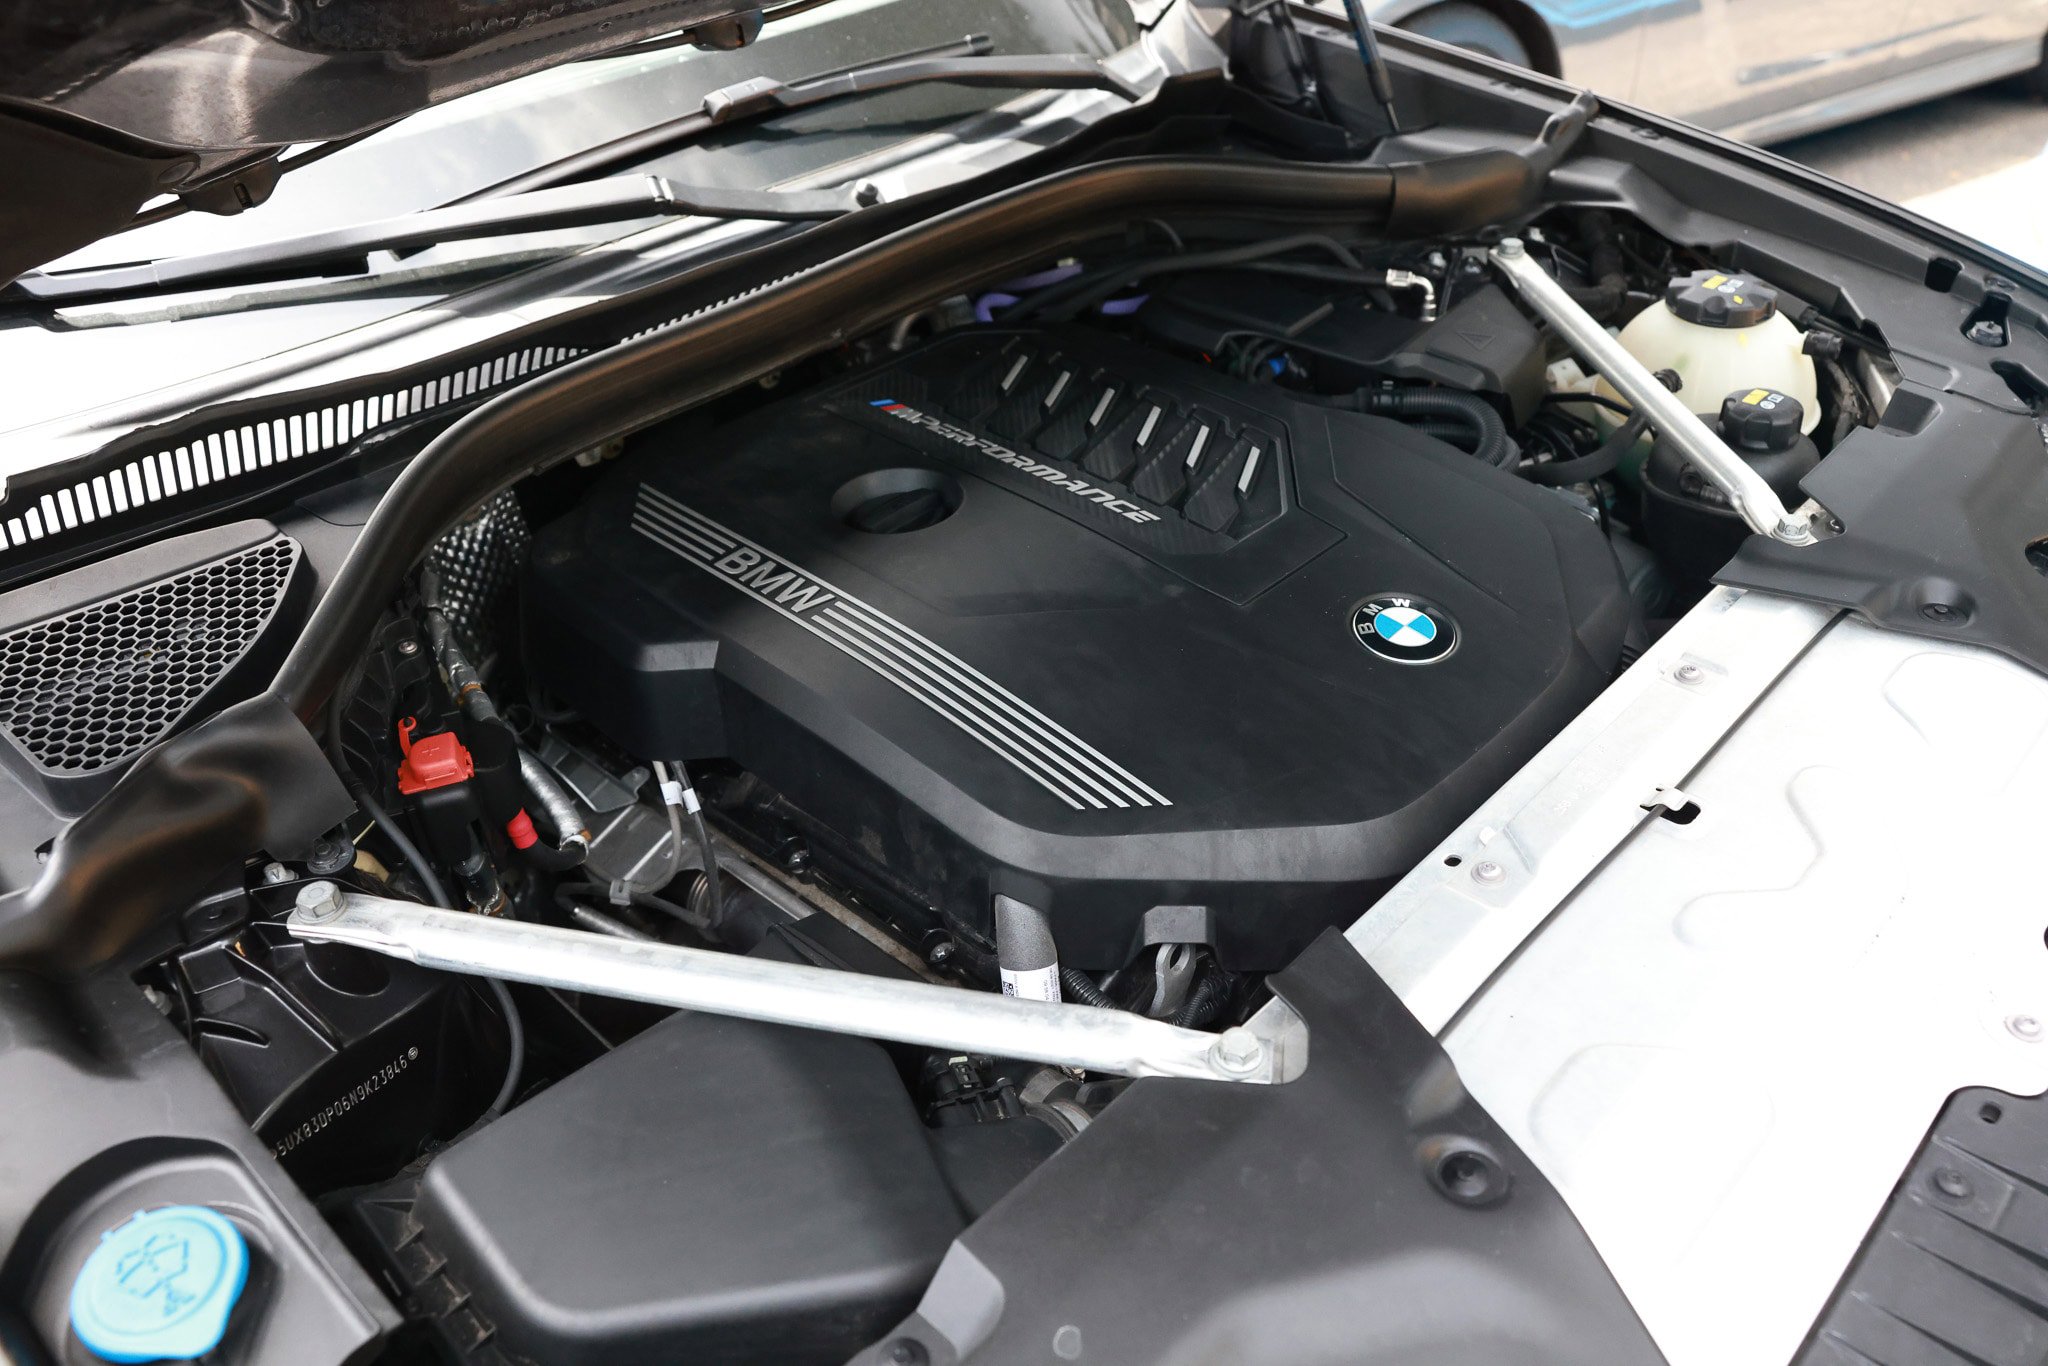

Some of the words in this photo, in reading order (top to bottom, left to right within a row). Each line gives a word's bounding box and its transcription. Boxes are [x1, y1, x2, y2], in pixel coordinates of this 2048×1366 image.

[713, 546, 836, 613] BMW
[1357, 598, 1411, 635] BMW
[277, 1054, 408, 1156] 5UX83DP06N9K23846
